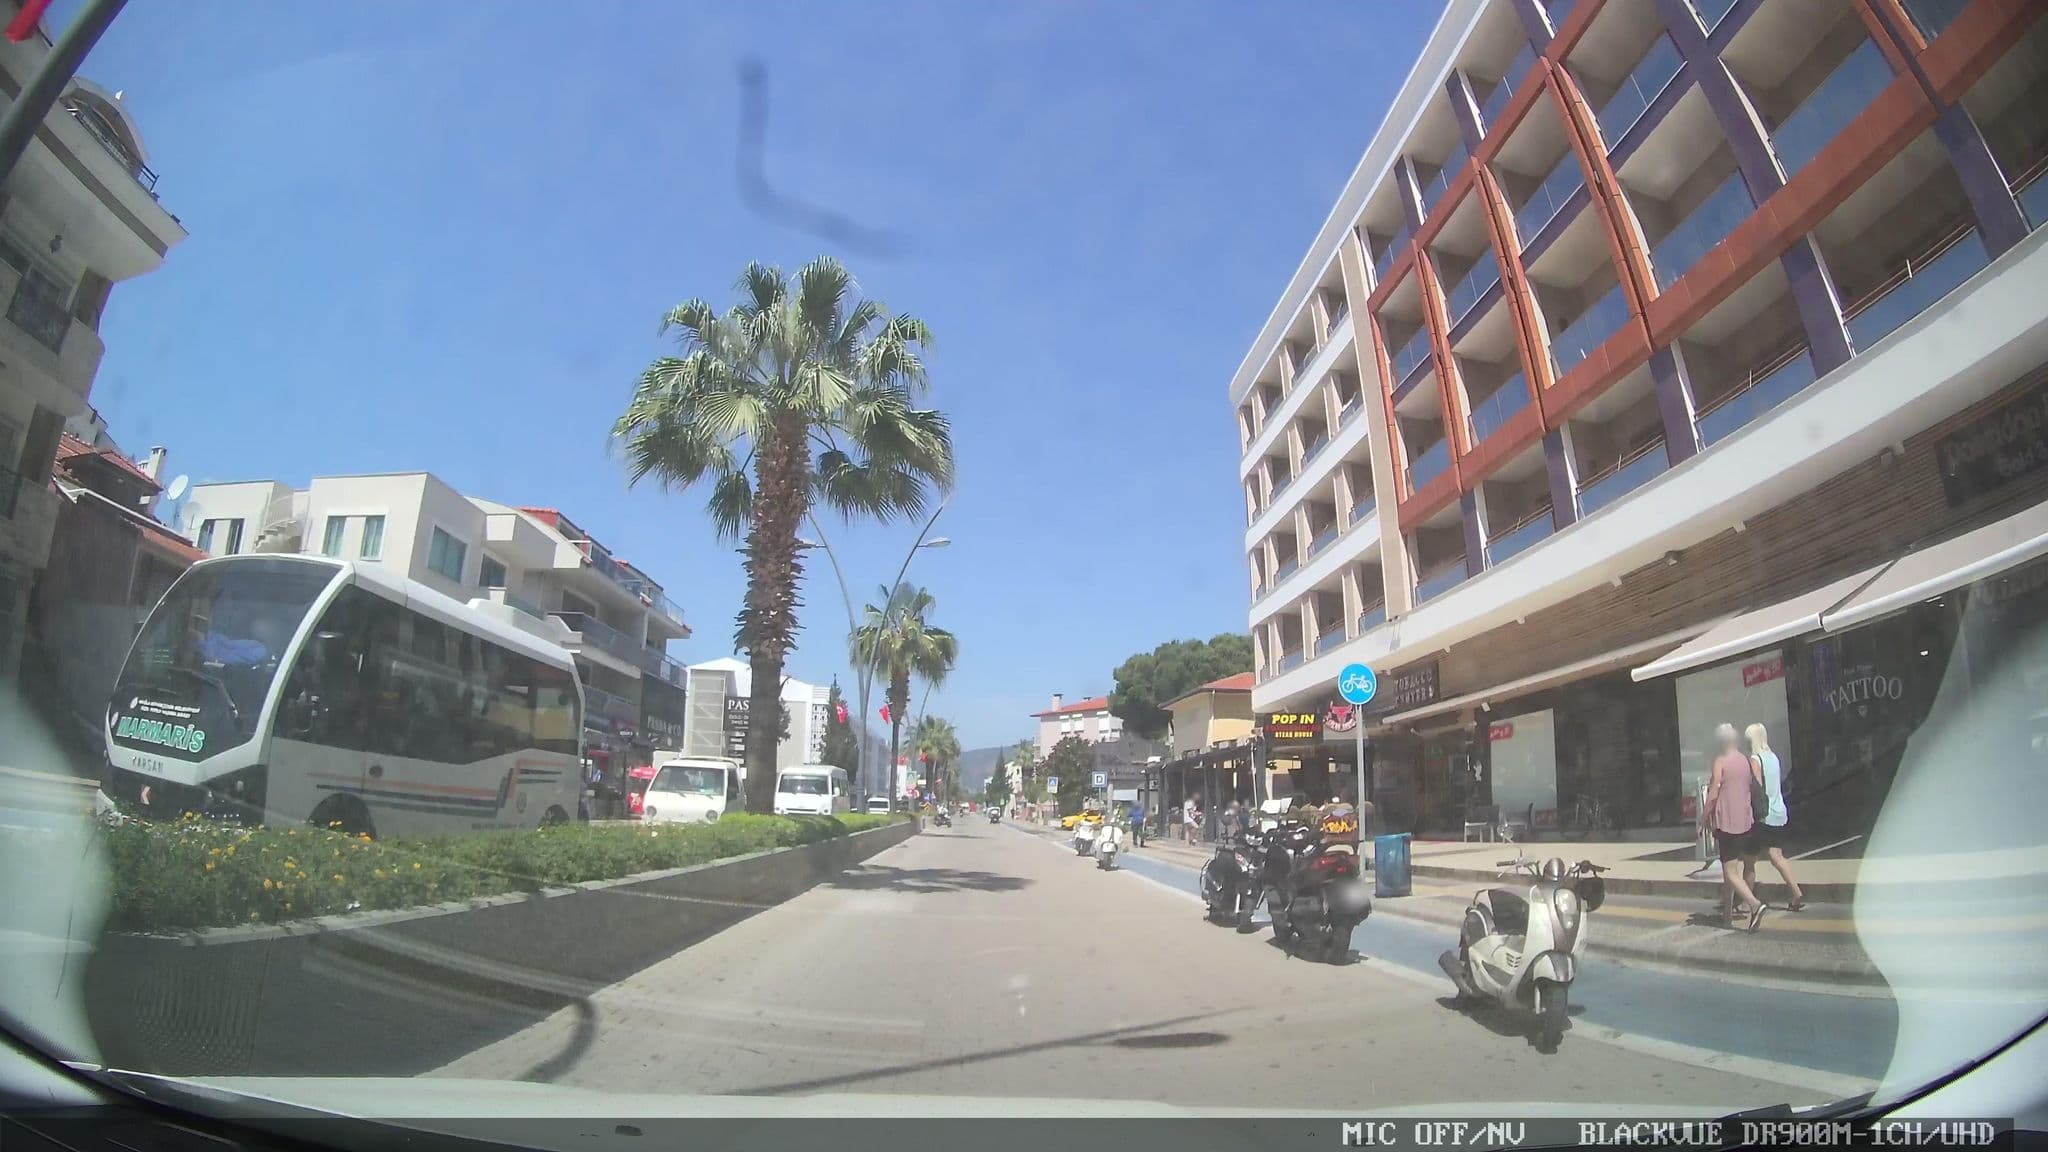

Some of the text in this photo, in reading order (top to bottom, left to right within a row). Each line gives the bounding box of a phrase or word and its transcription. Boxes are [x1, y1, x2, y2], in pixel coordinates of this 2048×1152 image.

[1825, 675, 1903, 713] TATTOO
[1271, 714, 1298, 724] POP
[1300, 714, 1315, 724] IN
